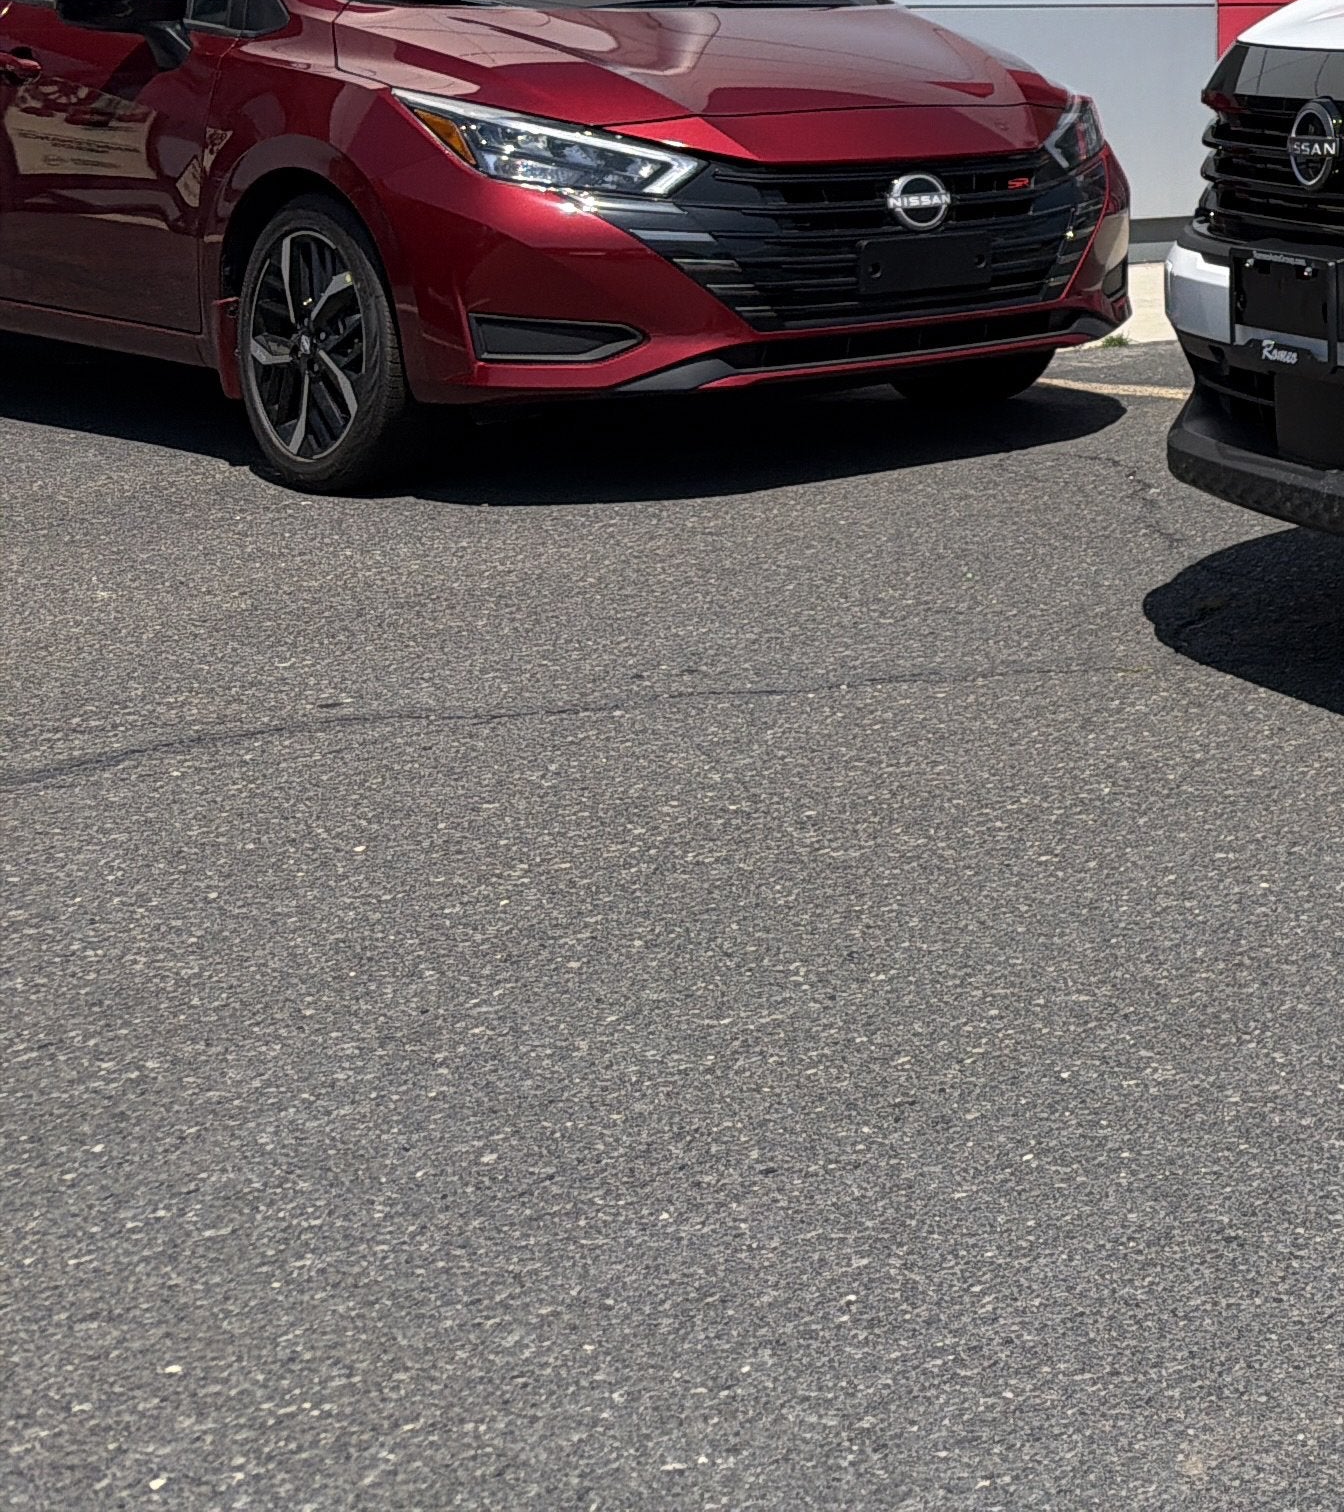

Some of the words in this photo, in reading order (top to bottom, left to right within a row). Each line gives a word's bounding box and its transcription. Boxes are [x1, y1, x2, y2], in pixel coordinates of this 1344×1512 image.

[1289, 141, 1336, 156] SSAN
[889, 194, 951, 208] NISSAN
[1262, 339, 1298, 364] Romeo
